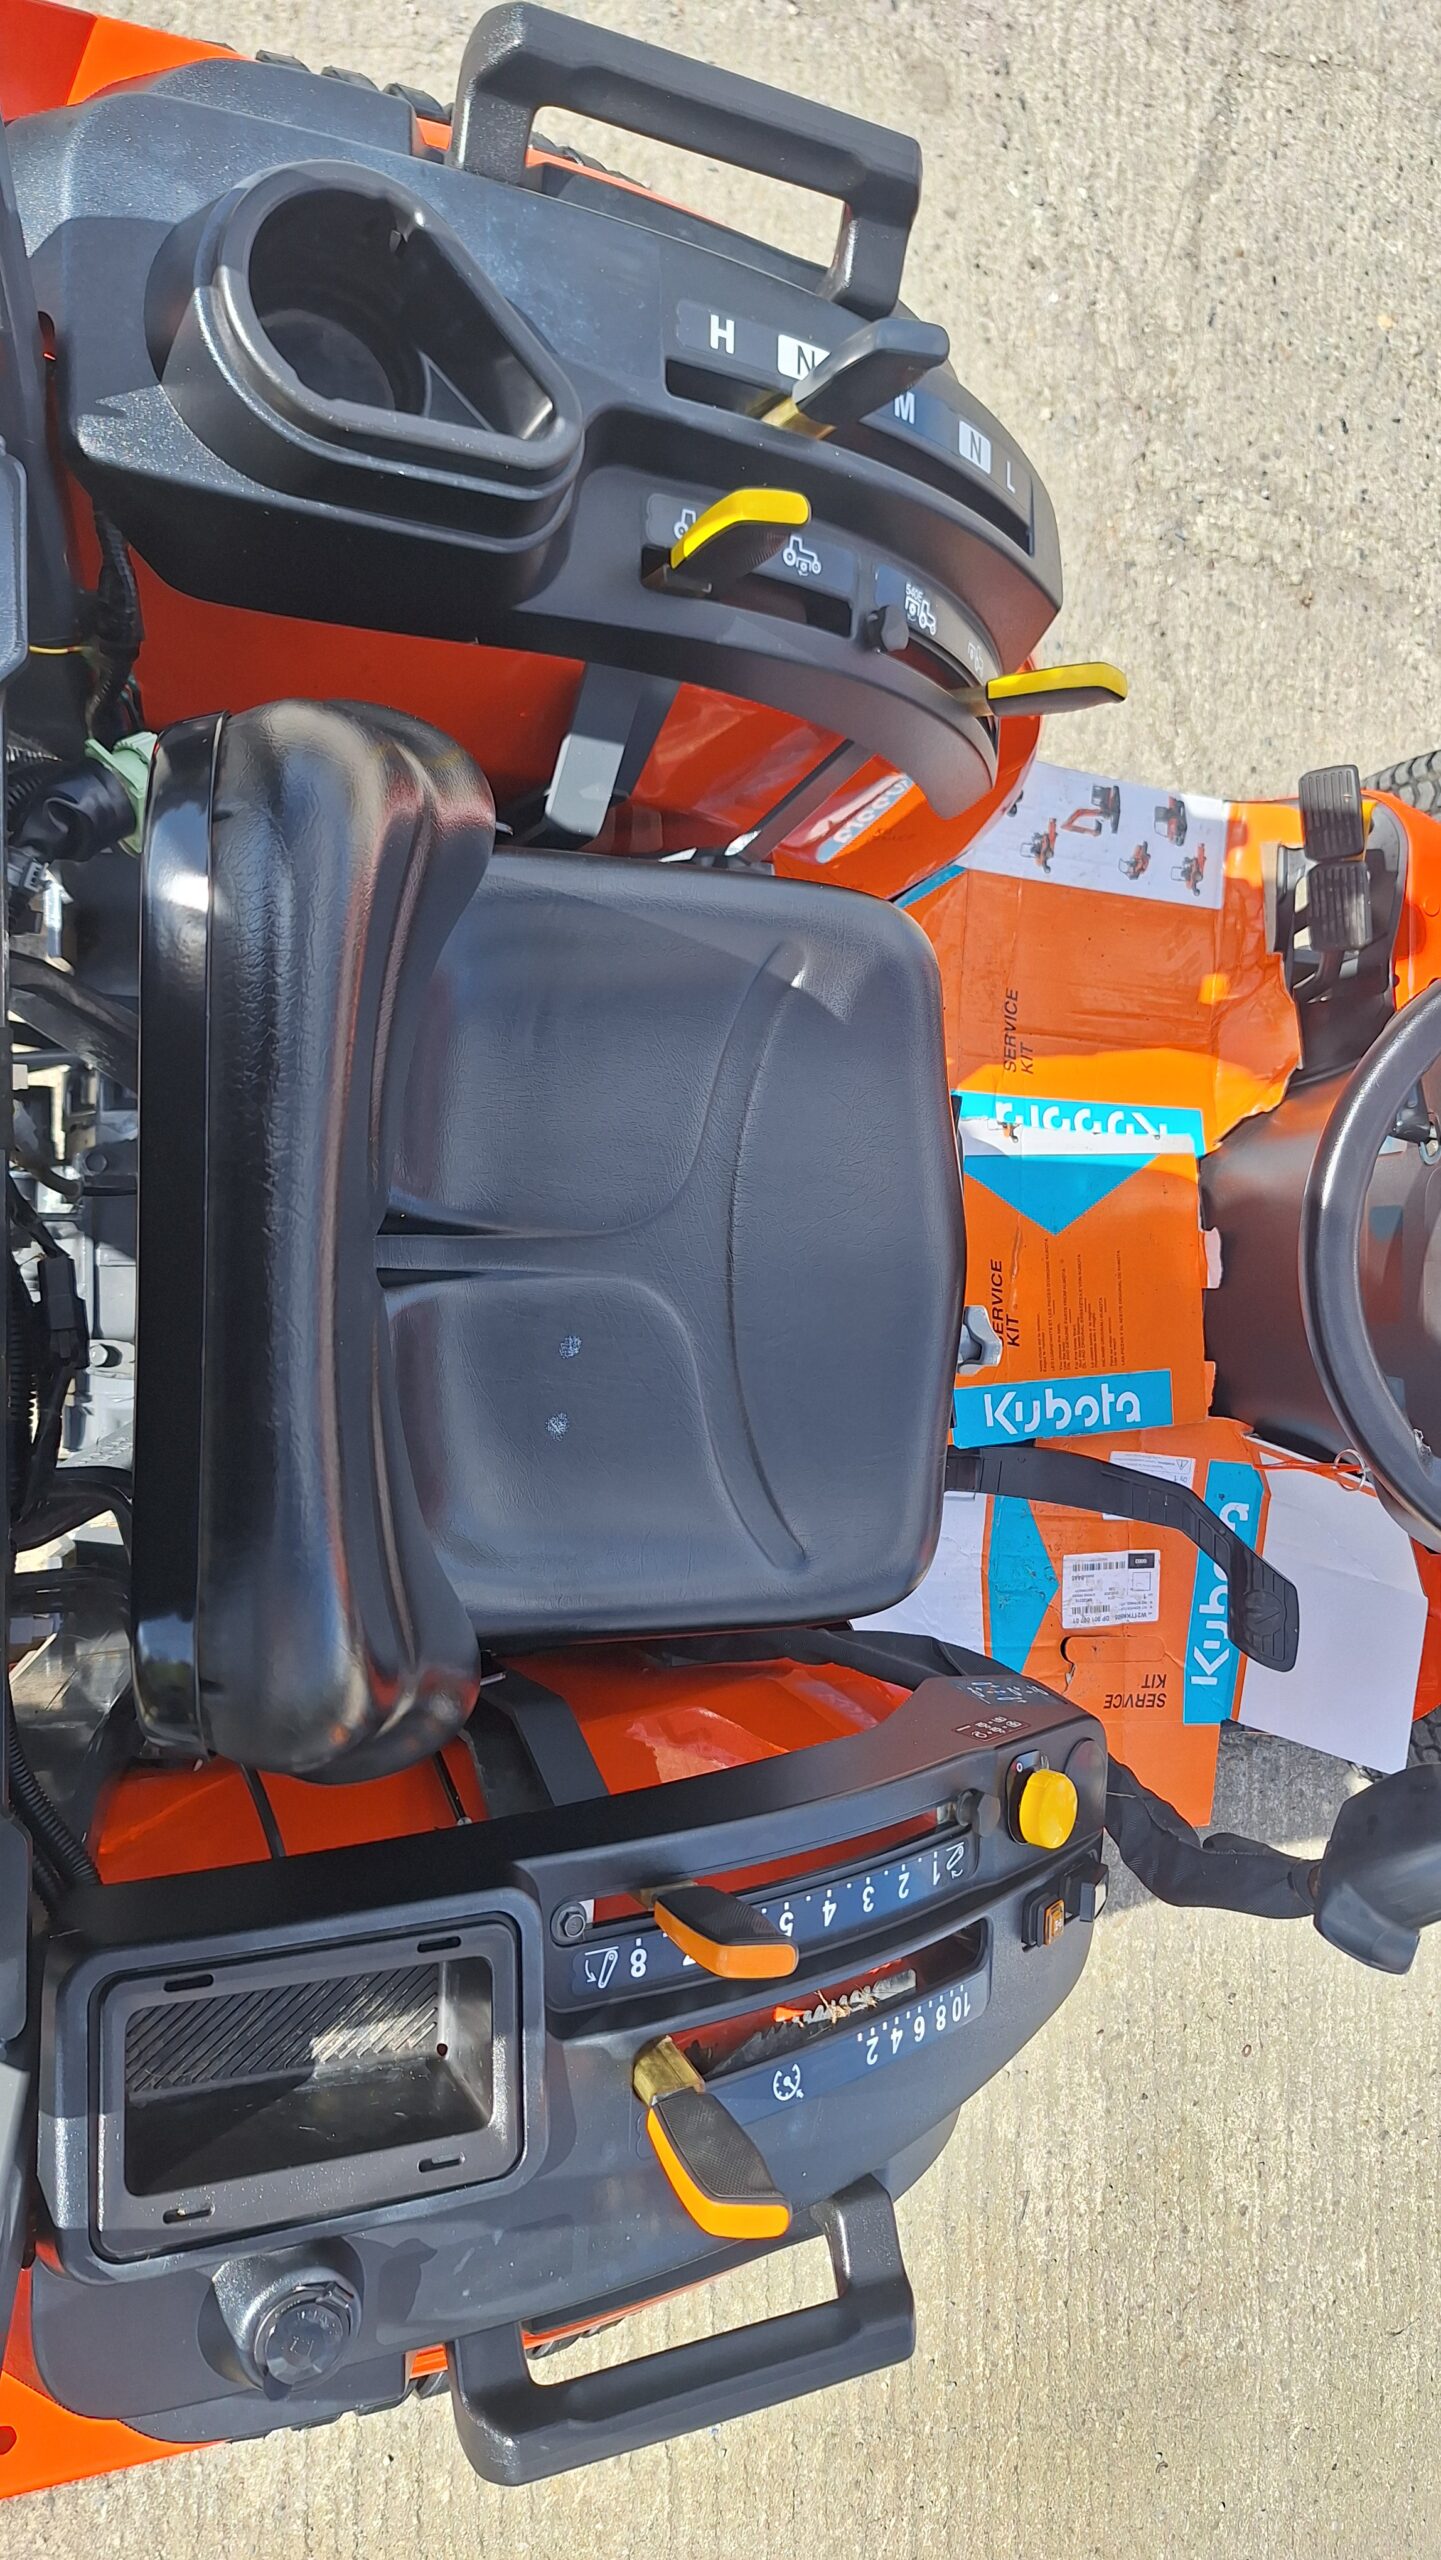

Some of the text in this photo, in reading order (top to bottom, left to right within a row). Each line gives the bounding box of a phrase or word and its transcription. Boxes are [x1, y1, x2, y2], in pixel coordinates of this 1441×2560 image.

[709, 313, 1016, 494] H N M N L
[1003, 987, 1018, 1073] SERVICE
[1020, 1041, 1034, 1075] KIT
[990, 1259, 1004, 1347] ERVICE
[1006, 1313, 1020, 1347] KIT
[983, 1383, 1142, 1435] Kubota
[1190, 1501, 1250, 1686] Kuba
[1103, 1692, 1167, 1709] SERVICE
[1141, 1674, 1167, 1689] KIT
[630, 1860, 941, 1978] 1 2 3 4 5 8
[866, 1991, 971, 2065] 10 8 6 4 2
